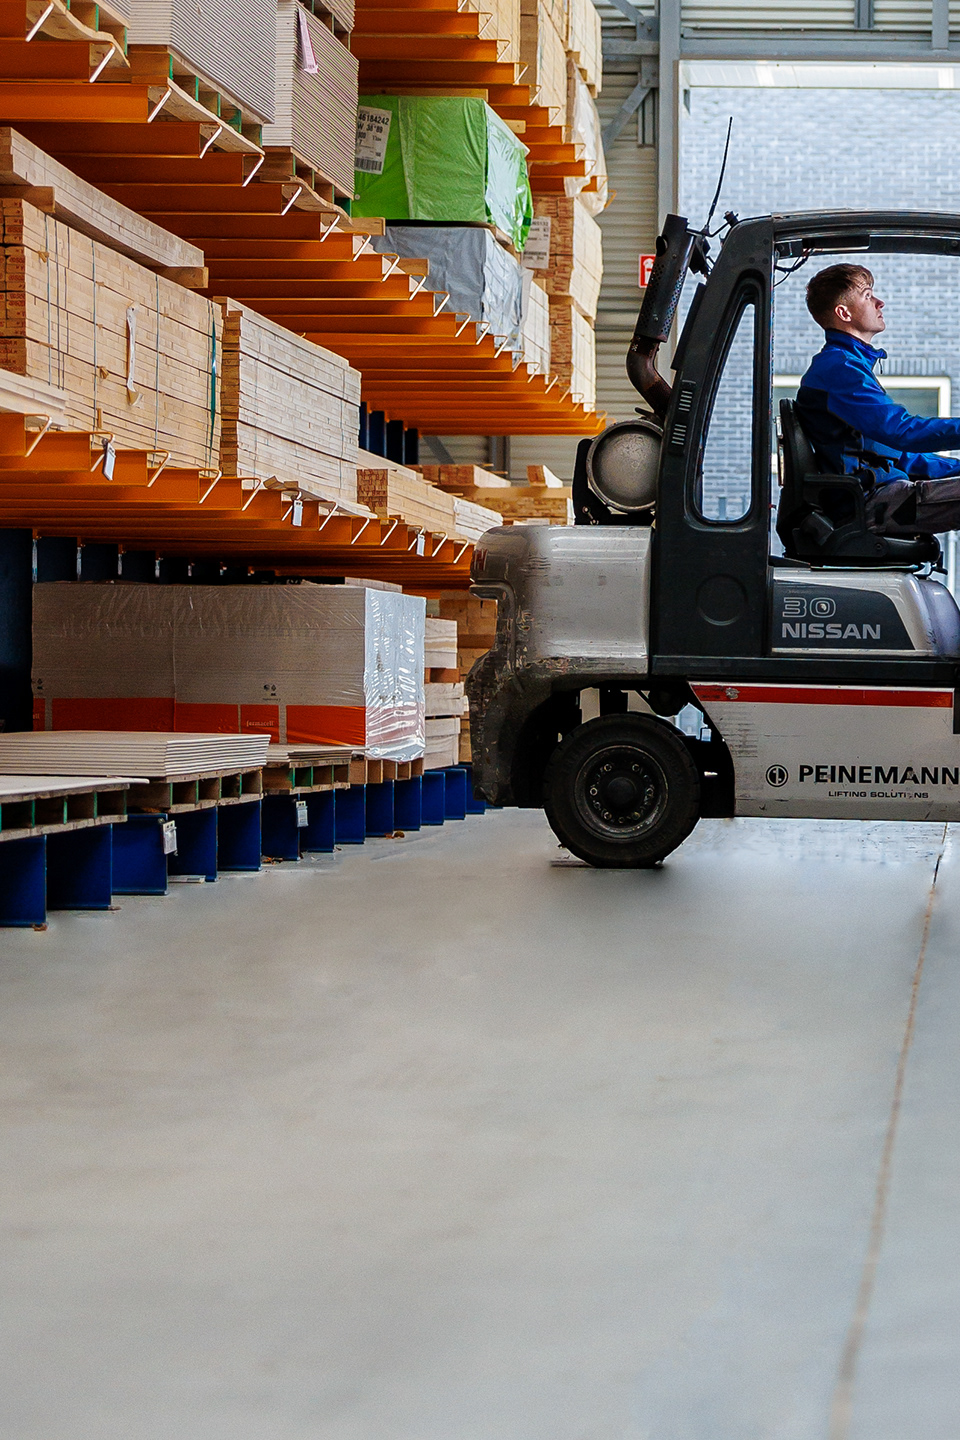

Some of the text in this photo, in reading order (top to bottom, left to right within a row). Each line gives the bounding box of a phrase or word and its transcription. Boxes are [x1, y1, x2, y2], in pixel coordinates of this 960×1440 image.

[782, 597, 836, 618] 30
[782, 623, 881, 639] NISSAN
[800, 765, 959, 785] PEINEMANN
